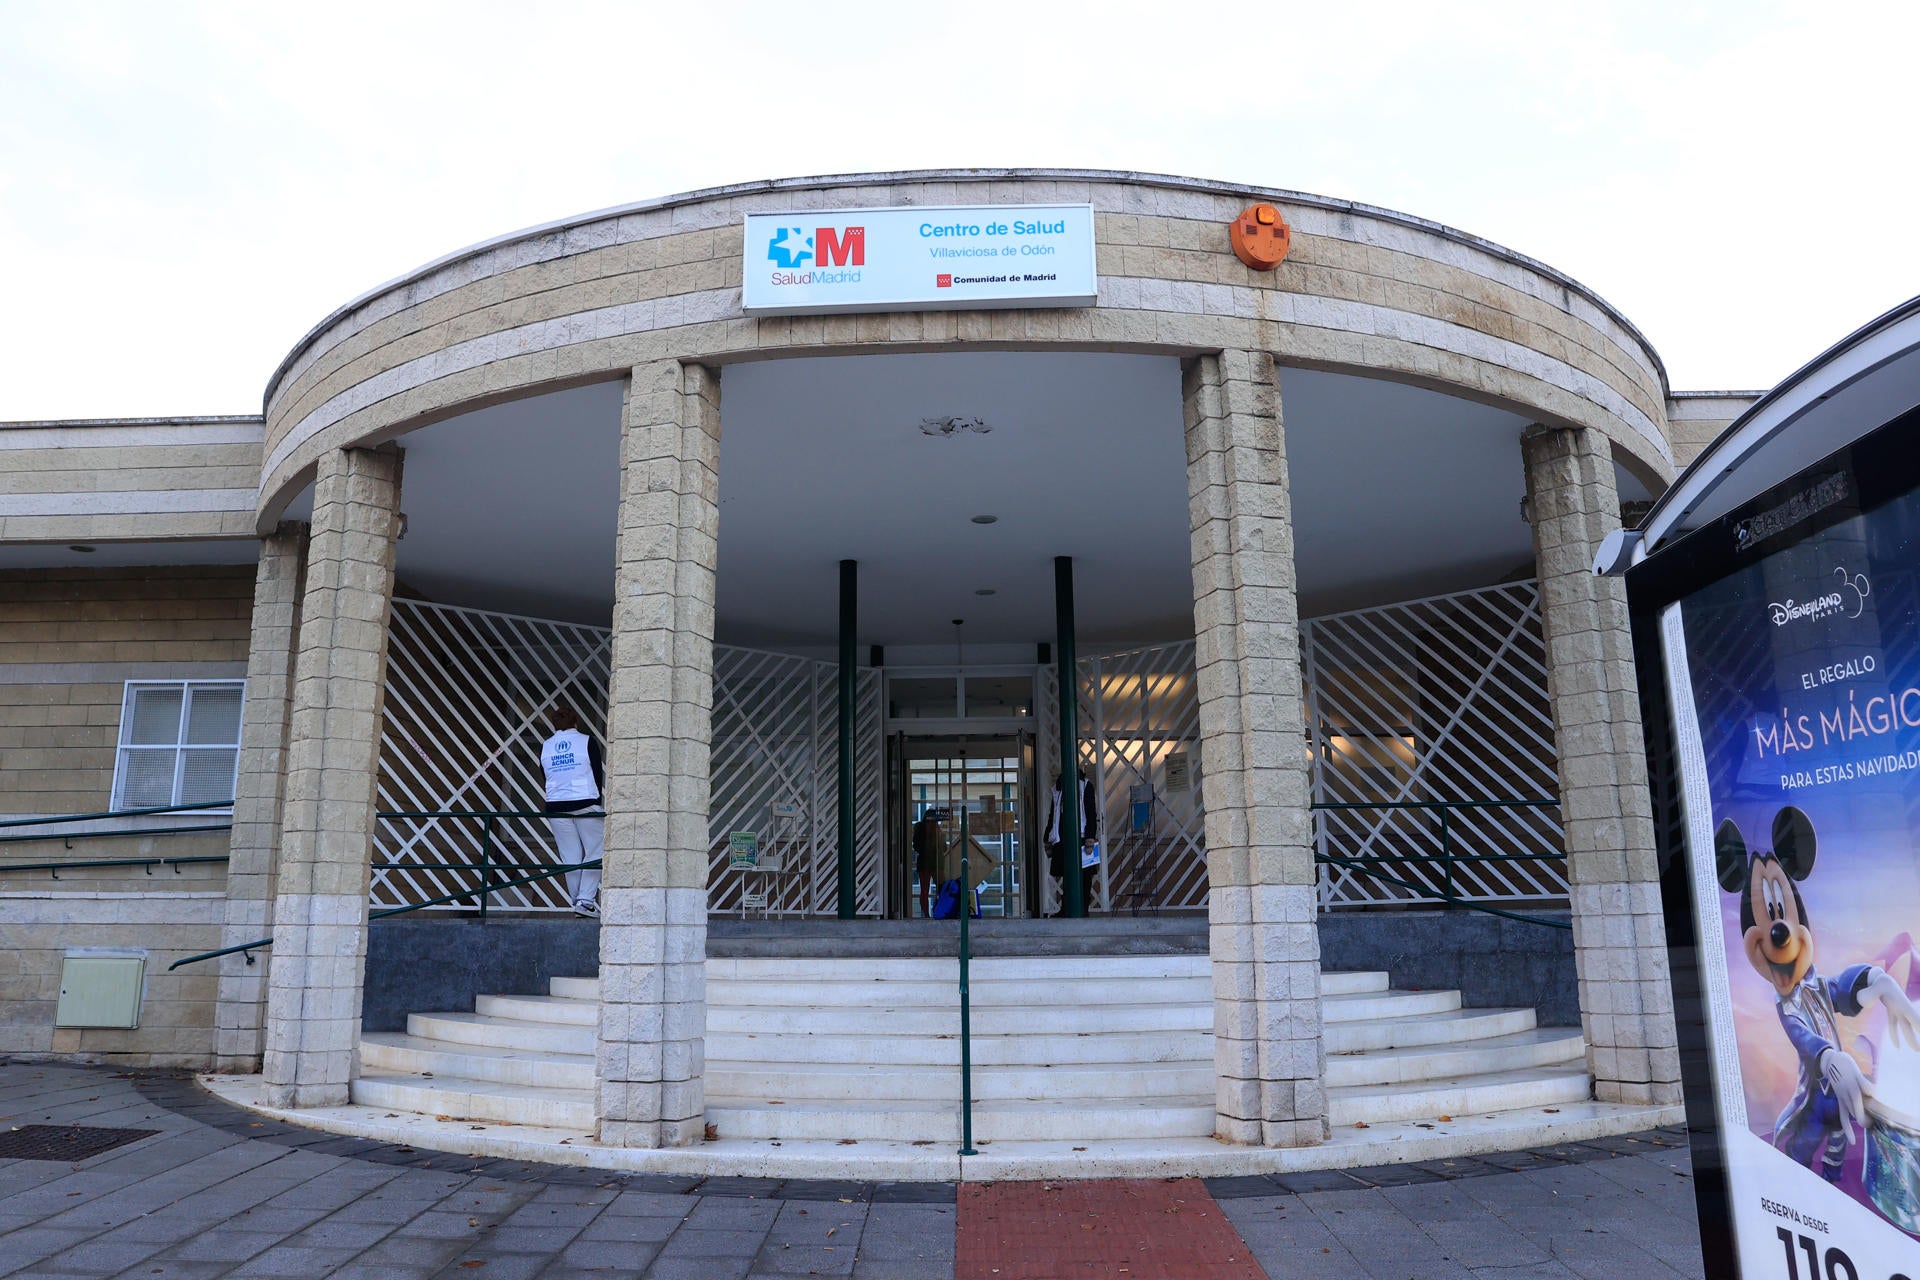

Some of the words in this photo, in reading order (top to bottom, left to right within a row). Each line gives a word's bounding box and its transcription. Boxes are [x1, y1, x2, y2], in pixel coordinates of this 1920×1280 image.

[919, 222, 980, 238] Centro
[985, 221, 1008, 237] de
[1013, 219, 1065, 236] Salud
[929, 245, 999, 258] Villaviciosa
[1002, 245, 1017, 257] de
[1020, 244, 1055, 256] Odón
[771, 270, 861, 286] SaludMadrid
[953, 274, 1007, 284] Comunidad
[1009, 273, 1021, 283] de
[1024, 272, 1056, 282] Madrid
[1815, 605, 1845, 619] PARIS
[1802, 672, 1818, 690] EL
[1819, 655, 1876, 685] REGALO
[1756, 706, 1815, 759] MÁS
[551, 753, 574, 761] UNHCR
[552, 758, 575, 766] ACNUR
[1781, 771, 1814, 791] PARA
[1816, 763, 1854, 786] ESTAS
[1857, 750, 1920, 779] NAVIDAD
[1761, 1197, 1801, 1223] RESERVA
[1802, 1214, 1830, 1234] DESDE
